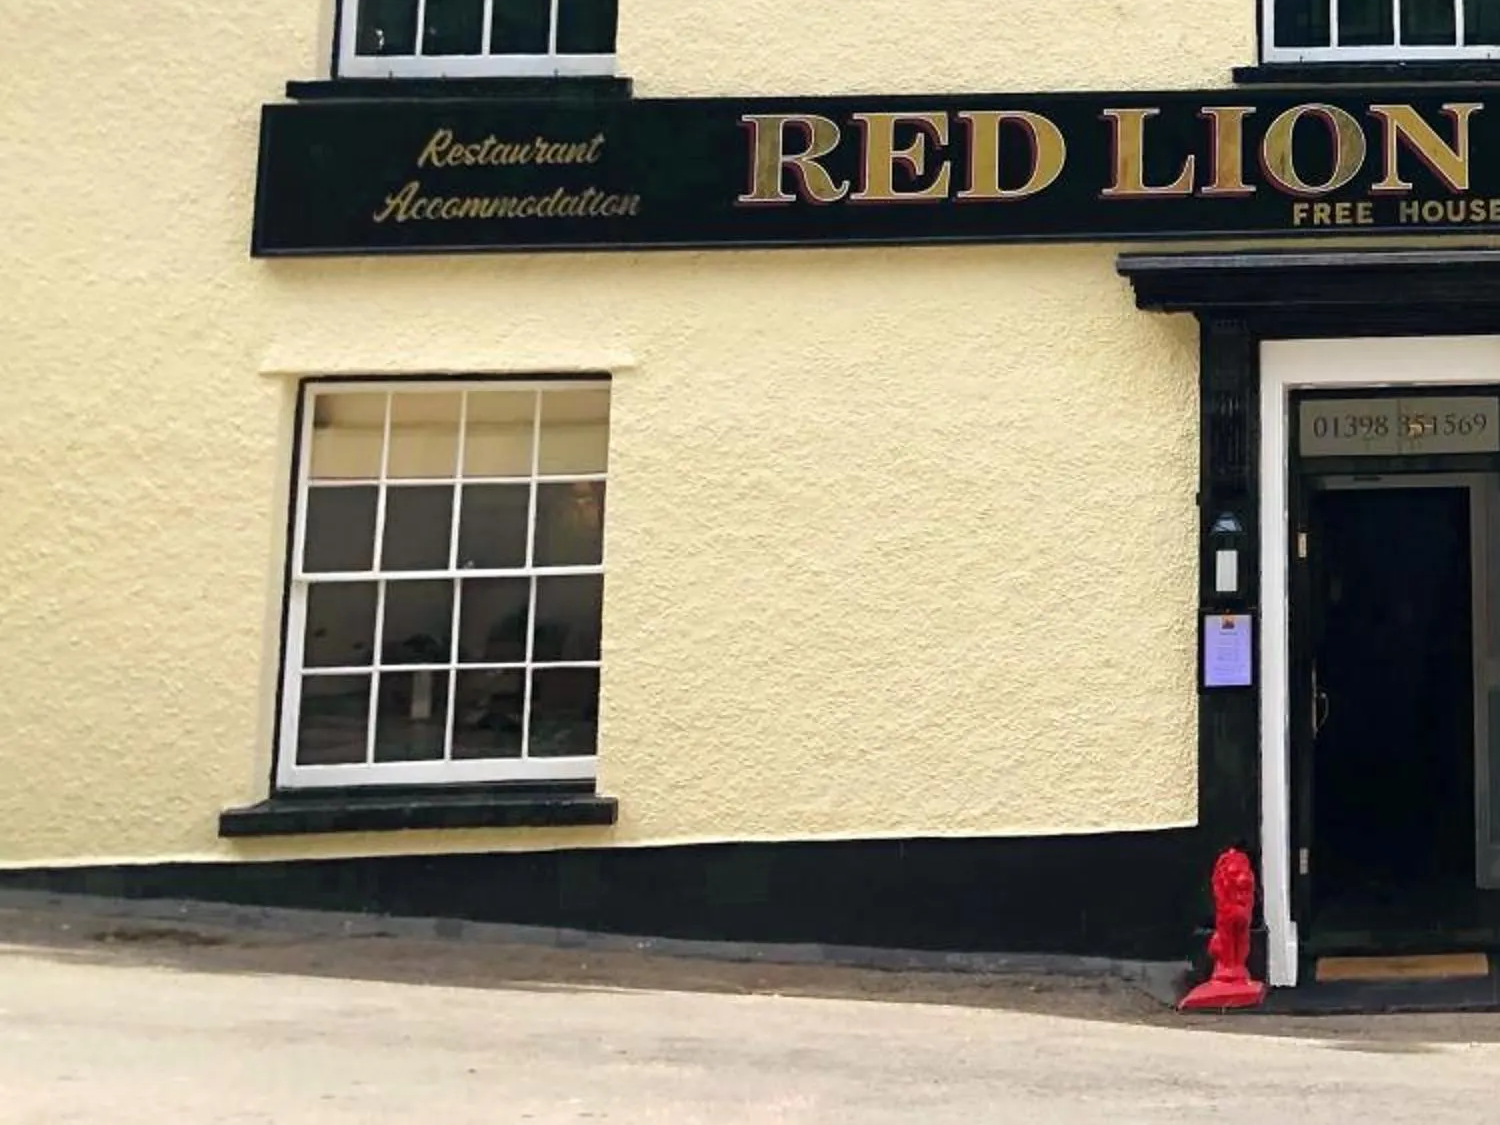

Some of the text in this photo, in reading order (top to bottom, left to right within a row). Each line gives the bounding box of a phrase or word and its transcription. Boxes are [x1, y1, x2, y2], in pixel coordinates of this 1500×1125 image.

[417, 128, 605, 168] Restaurant
[735, 110, 1067, 207] RED
[1100, 101, 1485, 197] LION
[373, 180, 640, 223] Accommodation
[1293, 202, 1374, 225] FREE
[1313, 413, 1487, 439] 01398 351569
